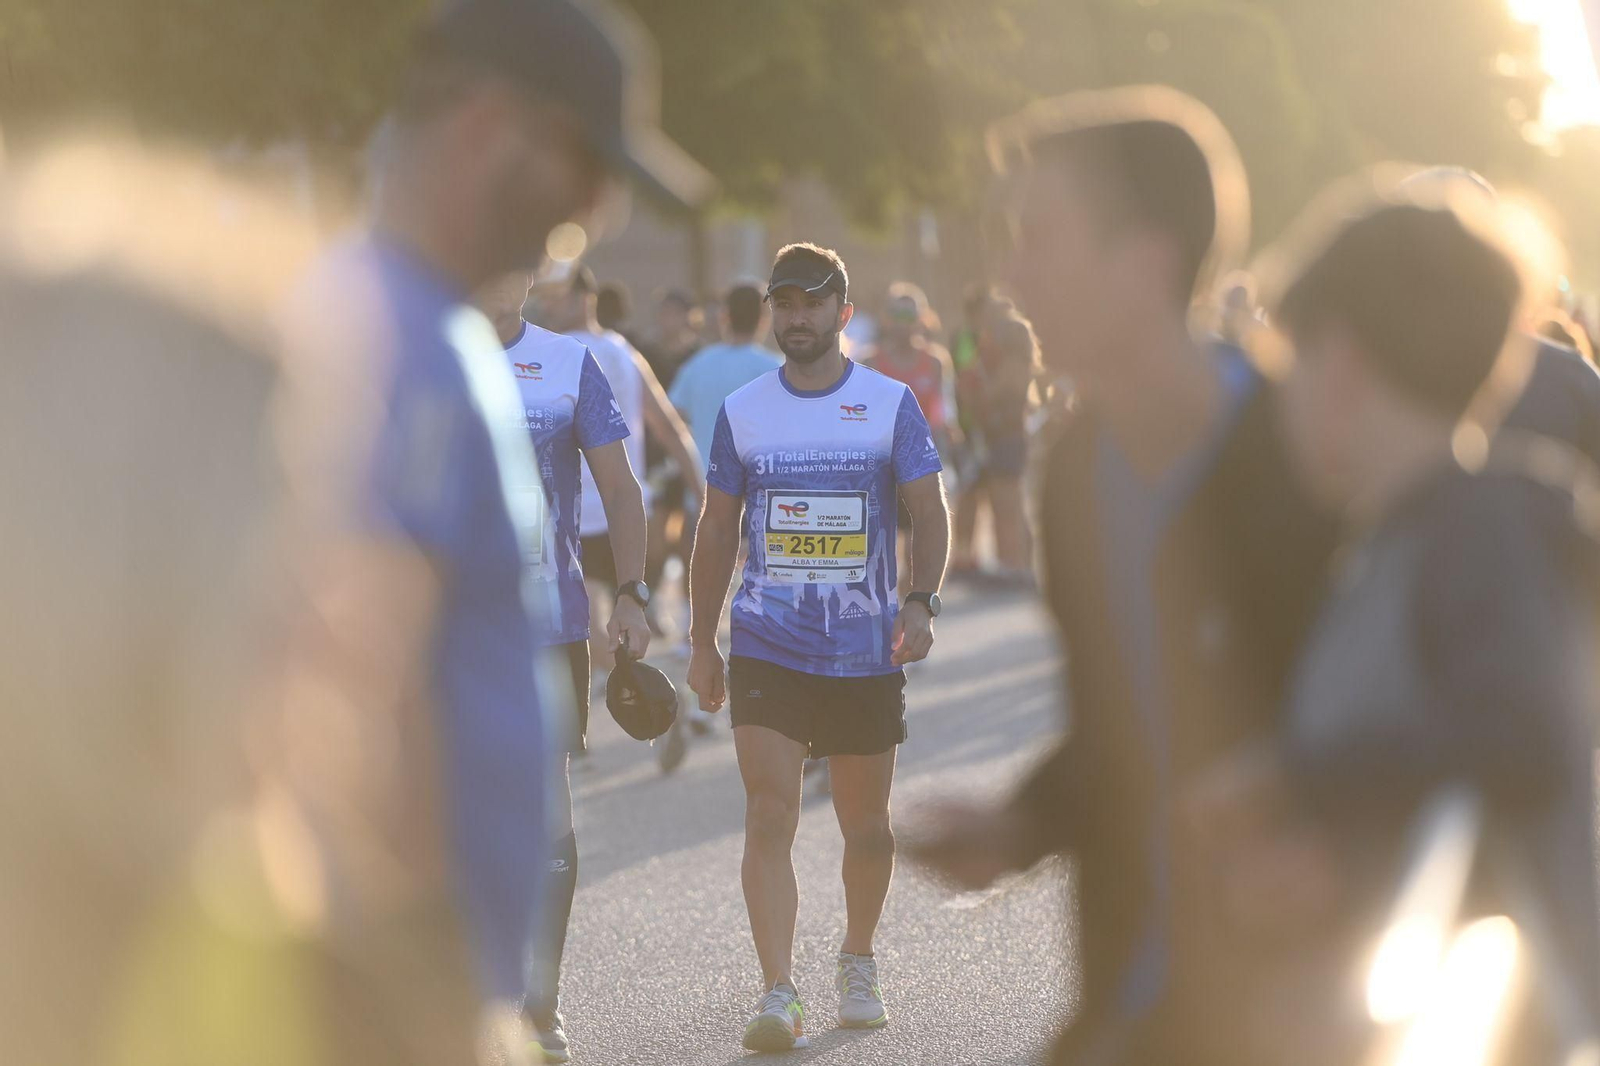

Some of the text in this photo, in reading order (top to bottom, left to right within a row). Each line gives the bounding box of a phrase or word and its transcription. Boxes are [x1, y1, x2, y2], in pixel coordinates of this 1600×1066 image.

[755, 453, 774, 475] 31
[777, 449, 866, 462] TotalEnergies
[867, 449, 876, 471] 2022
[777, 463, 865, 474] 1/2 MARATÓN MÁLAGA
[790, 535, 842, 555] 2517
